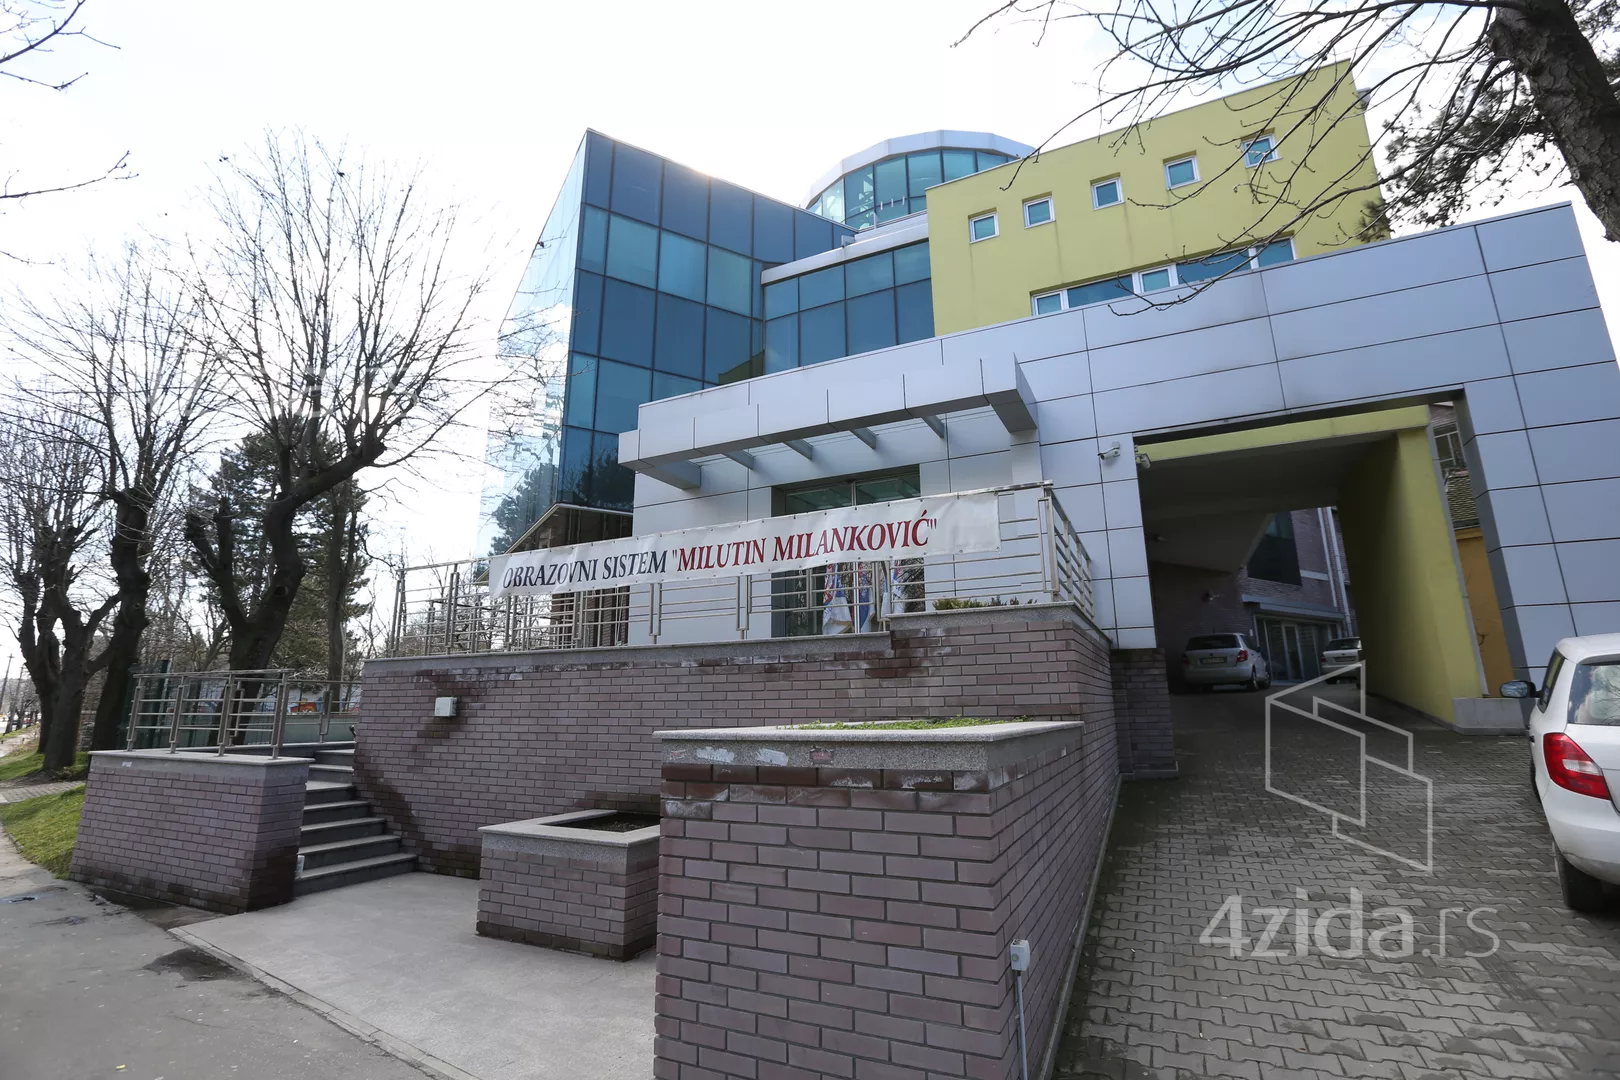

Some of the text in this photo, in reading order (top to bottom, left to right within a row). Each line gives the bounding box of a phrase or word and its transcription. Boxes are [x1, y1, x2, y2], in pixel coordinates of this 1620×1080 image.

[502, 510, 938, 589] OBRAZOVNI SISTEM "MILUTIN MILANKOVIĆ"
